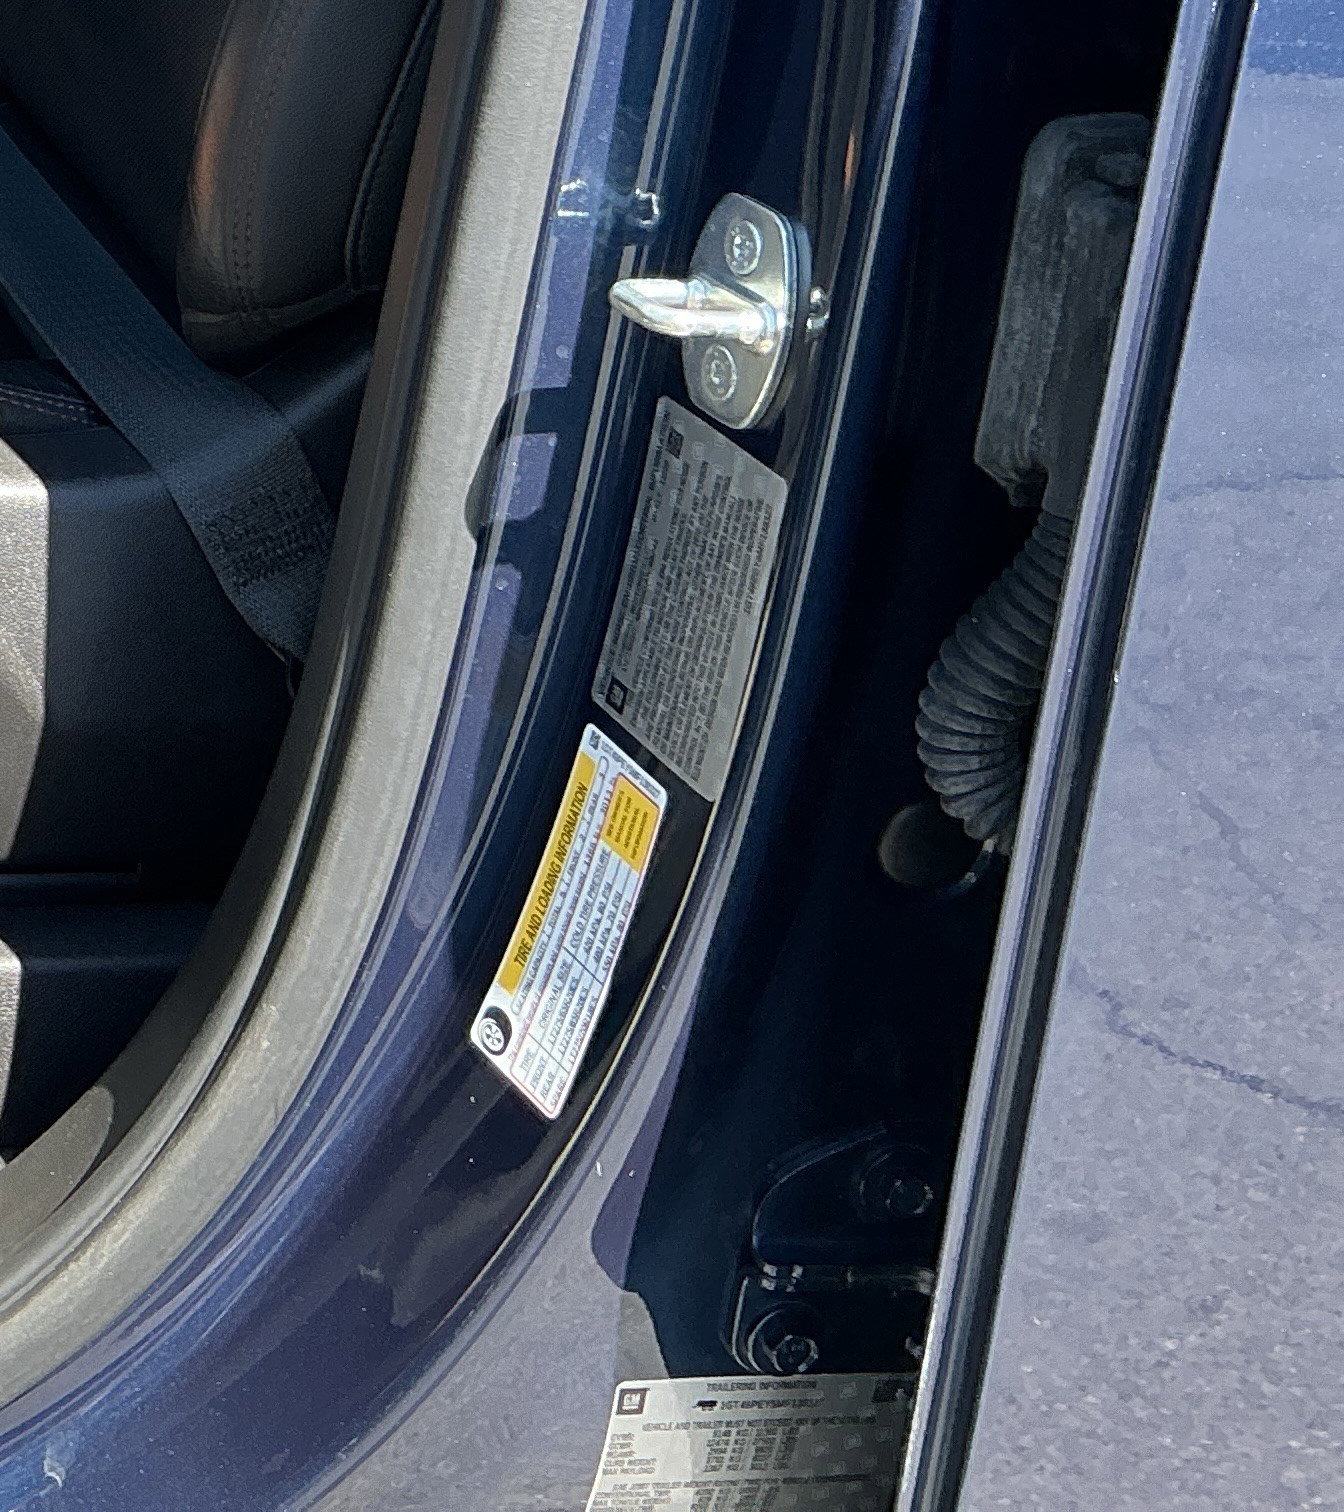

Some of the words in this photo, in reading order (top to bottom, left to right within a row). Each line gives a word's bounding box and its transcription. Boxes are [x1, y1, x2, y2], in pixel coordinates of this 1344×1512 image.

[513, 936, 532, 970] TIRE
[524, 910, 542, 942] AND
[534, 858, 562, 917] LOADING
[553, 781, 588, 864] INFORMATION
